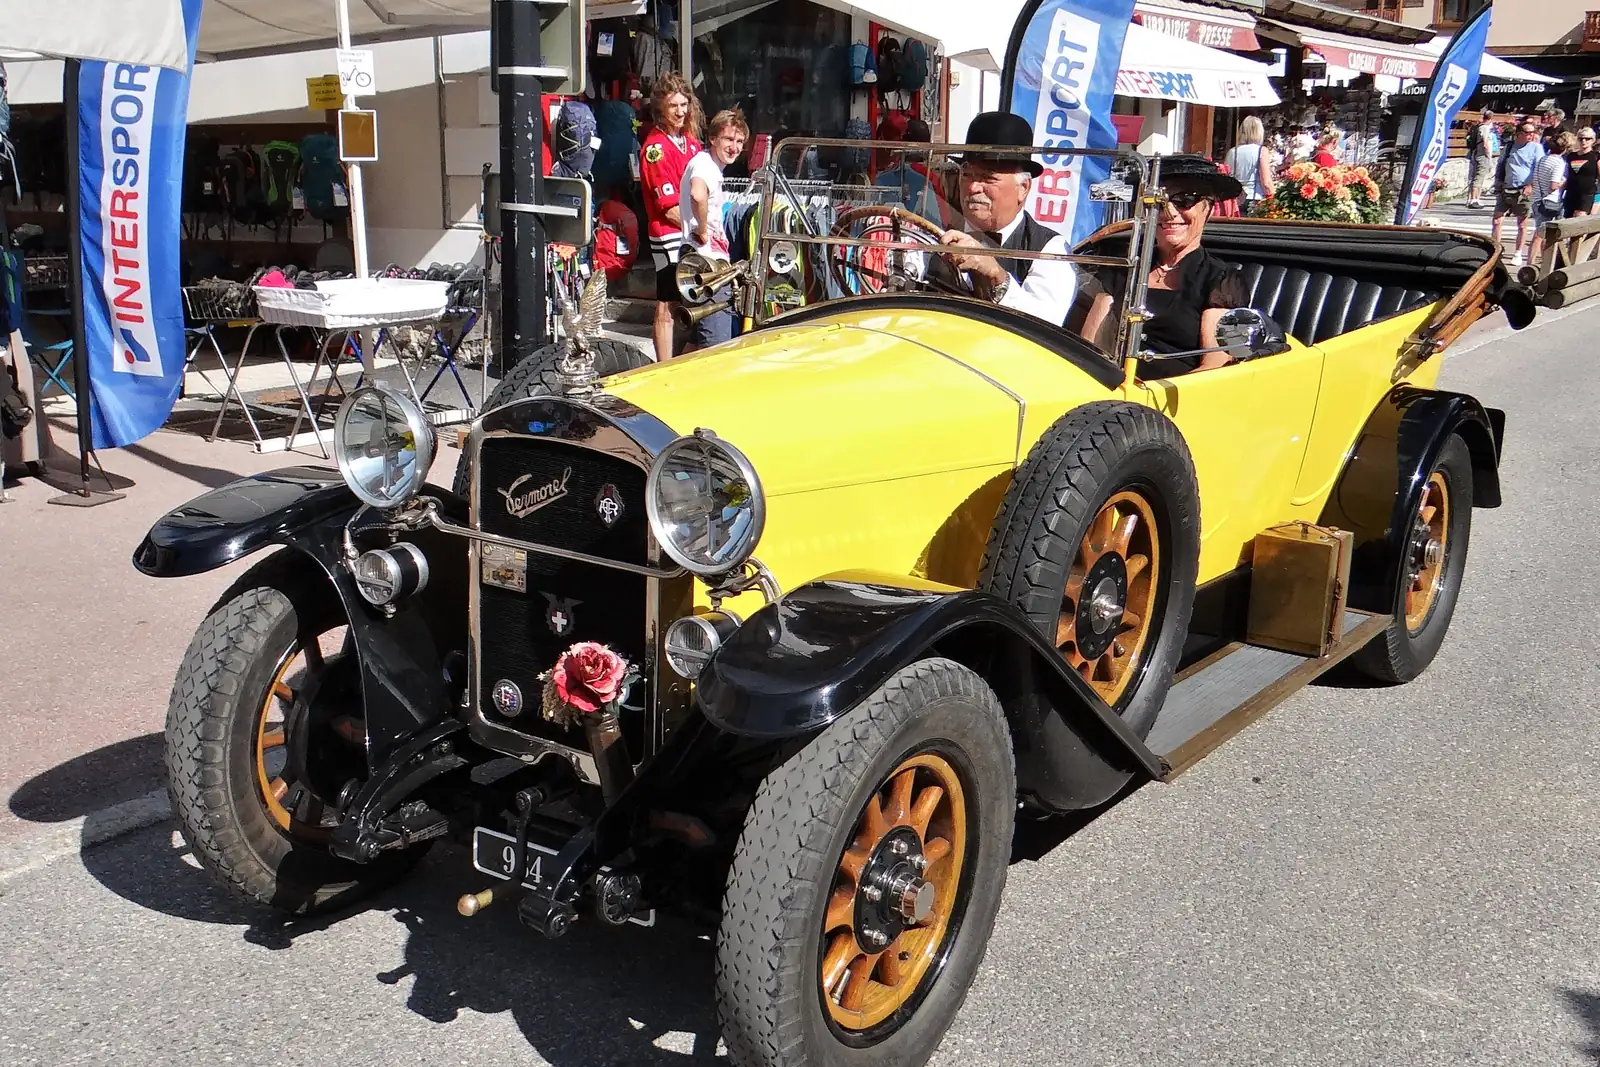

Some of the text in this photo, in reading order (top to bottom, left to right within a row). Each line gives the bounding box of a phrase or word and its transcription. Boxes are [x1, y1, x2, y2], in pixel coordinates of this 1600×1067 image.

[1348, 52, 1377, 72] CADEAUX
[1218, 80, 1256, 99] VENTE
[1481, 83, 1545, 94] SNOWBOARDS
[1034, 29, 1088, 224] ERSPORT
[109, 61, 151, 324] INTERSPOR
[497, 466, 572, 518] Vermorel
[502, 845, 543, 884] 94
